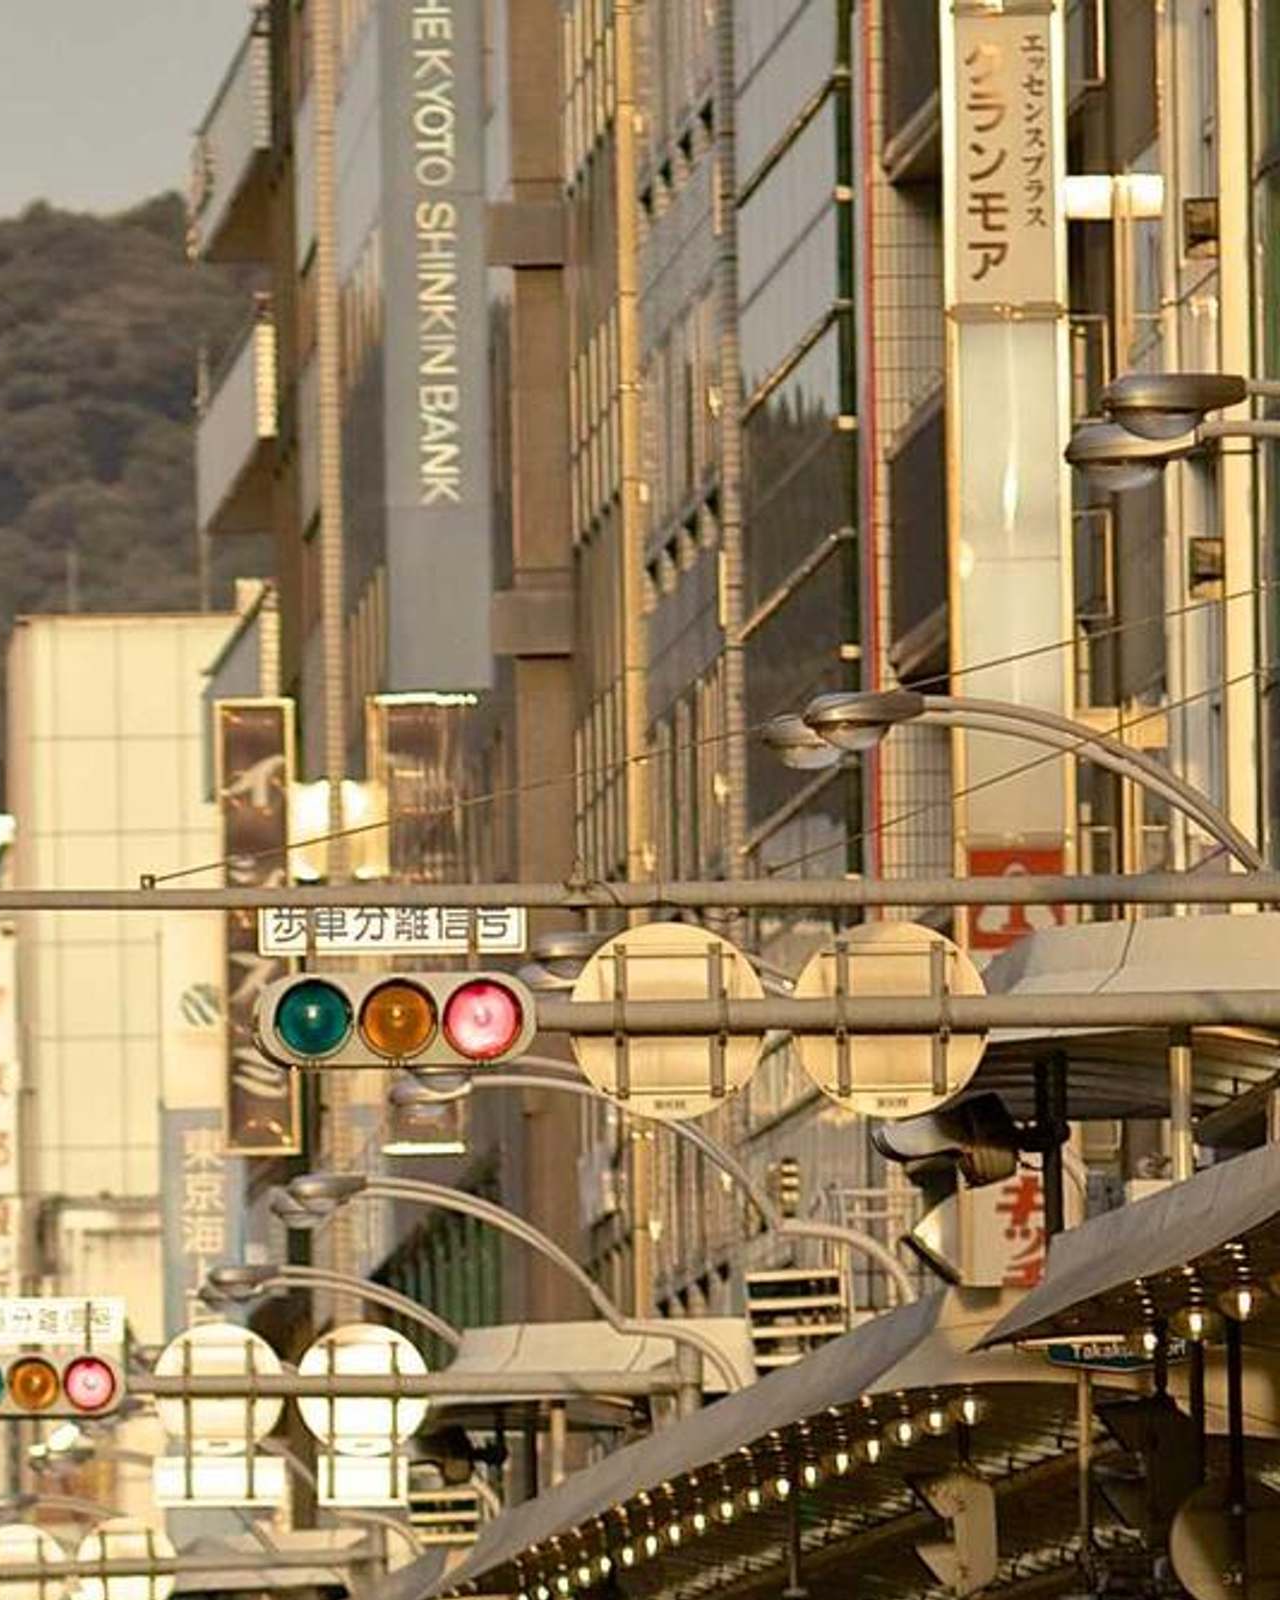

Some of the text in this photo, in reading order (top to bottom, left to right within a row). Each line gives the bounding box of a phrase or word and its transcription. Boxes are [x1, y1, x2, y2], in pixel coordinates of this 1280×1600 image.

[414, 50, 455, 187] KYOTO
[415, 202, 458, 375] SHINKIN
[420, 387, 461, 506] BANK
[273, 906, 511, 943] 歩車分離信号
